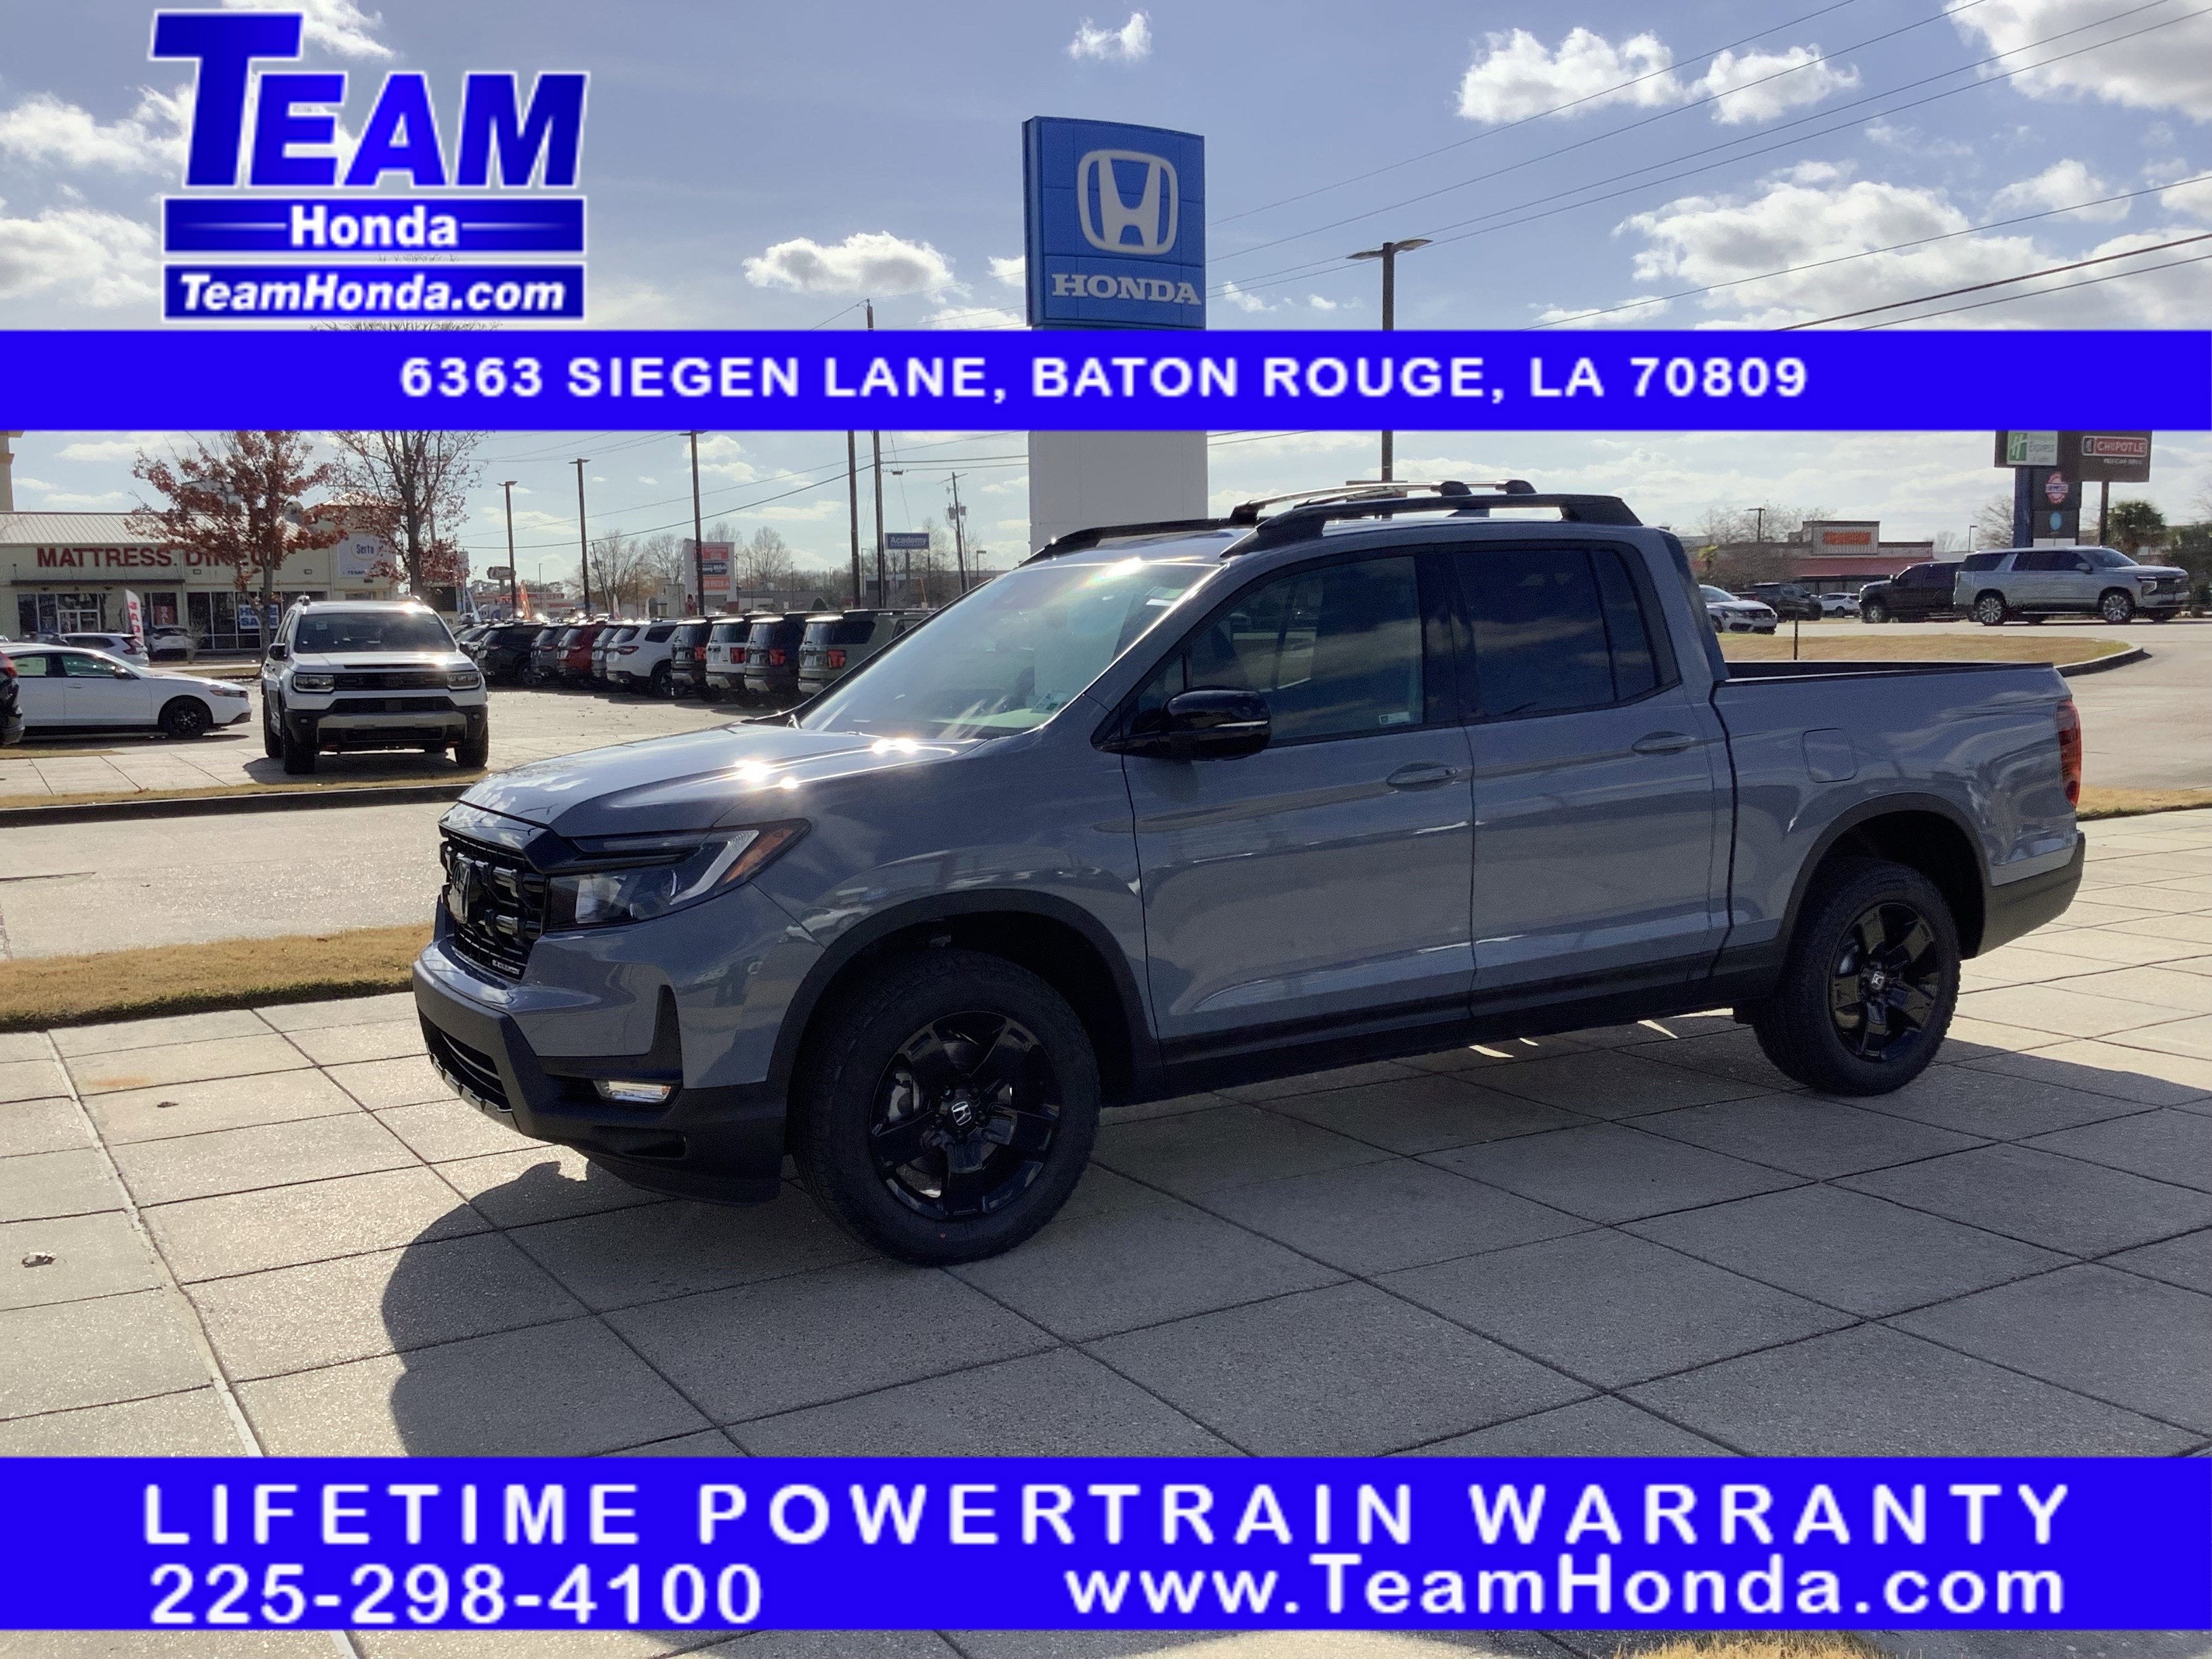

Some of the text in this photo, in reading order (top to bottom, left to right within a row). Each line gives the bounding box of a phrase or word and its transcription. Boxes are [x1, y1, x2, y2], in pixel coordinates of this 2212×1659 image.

[1052, 272, 1202, 306] HONDA
[2097, 441, 2146, 453] CHIPOTLE
[890, 535, 926, 545] Academy
[37, 546, 172, 568] MATTRESS
[241, 617, 278, 626] SAE
